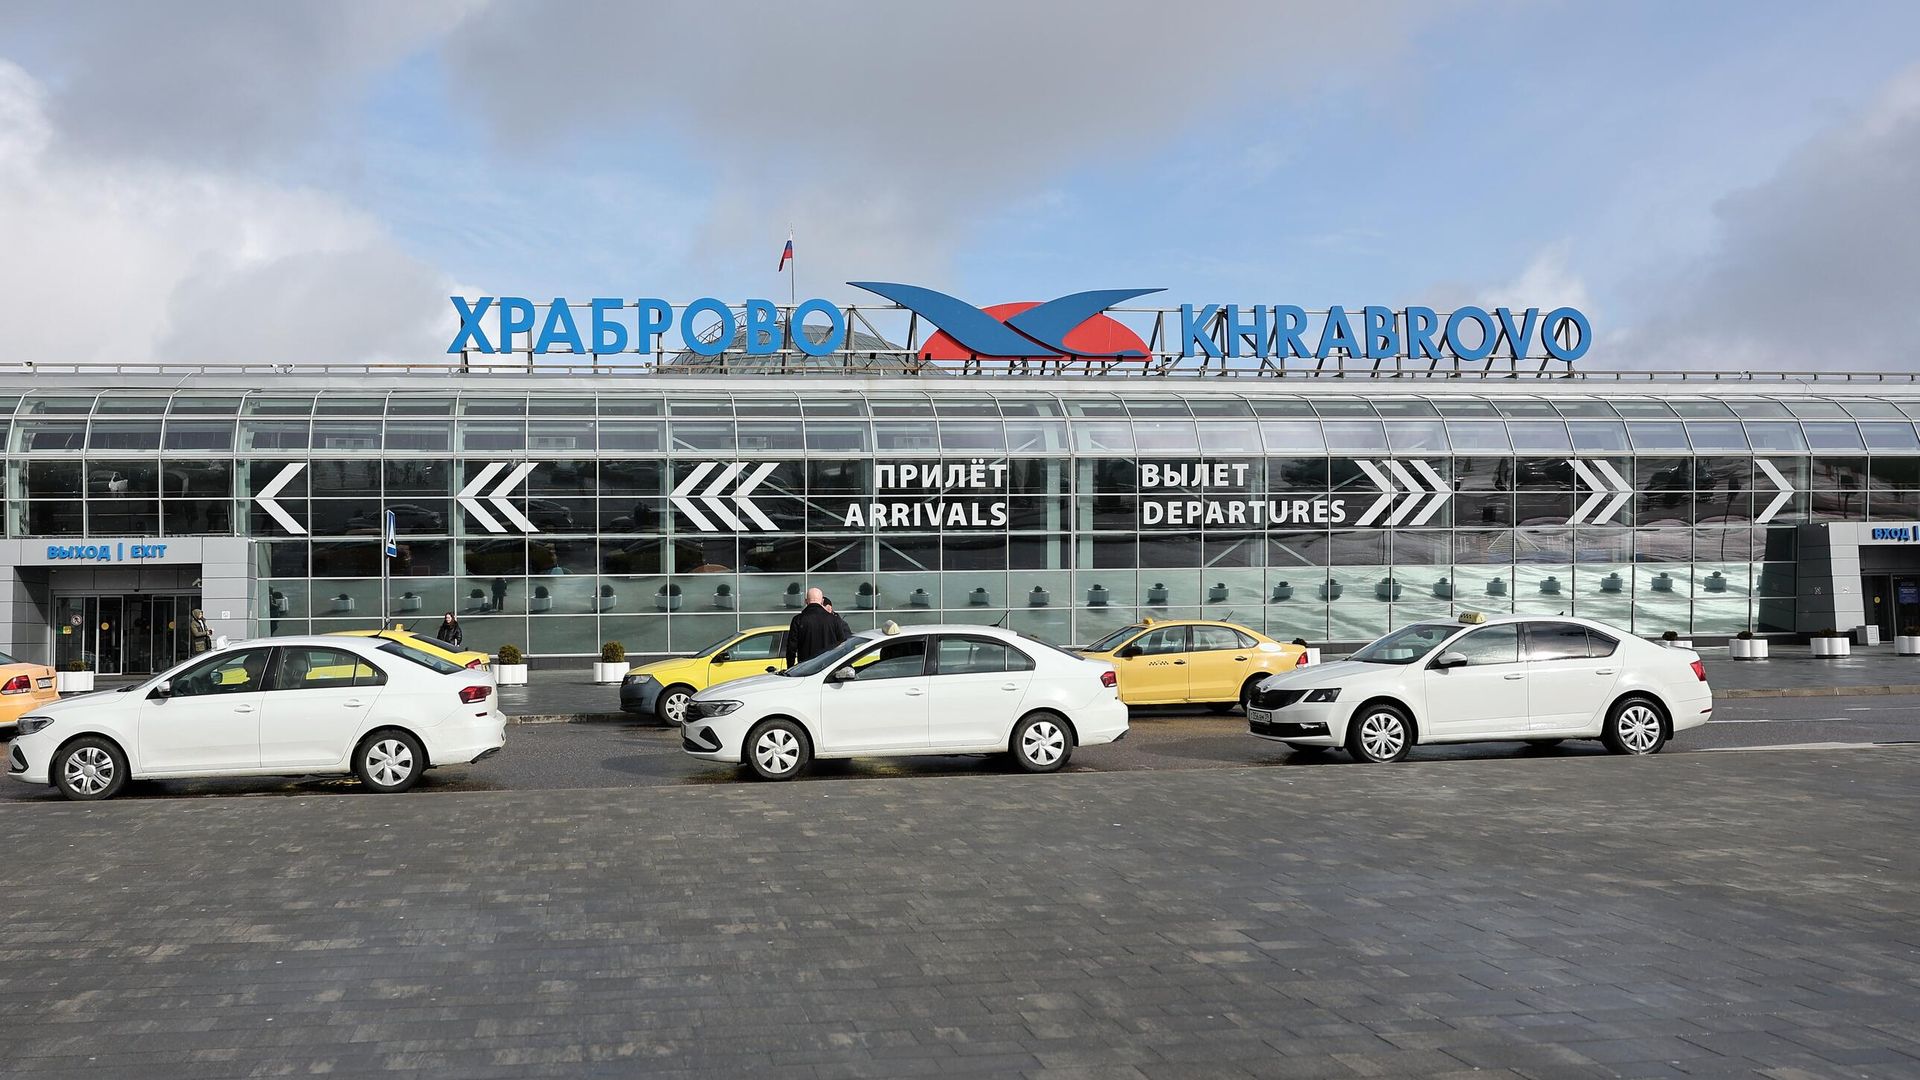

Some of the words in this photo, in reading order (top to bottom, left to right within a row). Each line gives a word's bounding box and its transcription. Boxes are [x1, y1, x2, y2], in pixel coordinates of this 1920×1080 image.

[447, 296, 845, 356] ХРАБРОВО
[1180, 303, 1592, 362] KHRABROVO
[875, 458, 1007, 488] ПРИЛЁТ
[1142, 463, 1249, 488] ВЫЛЕТ
[844, 502, 1007, 527] ARRIVALS
[1143, 500, 1346, 525] DEPARTURES
[1872, 527, 1909, 541] ВХОД
[47, 545, 111, 561] ВЫХОД
[130, 544, 168, 559] EXIT
